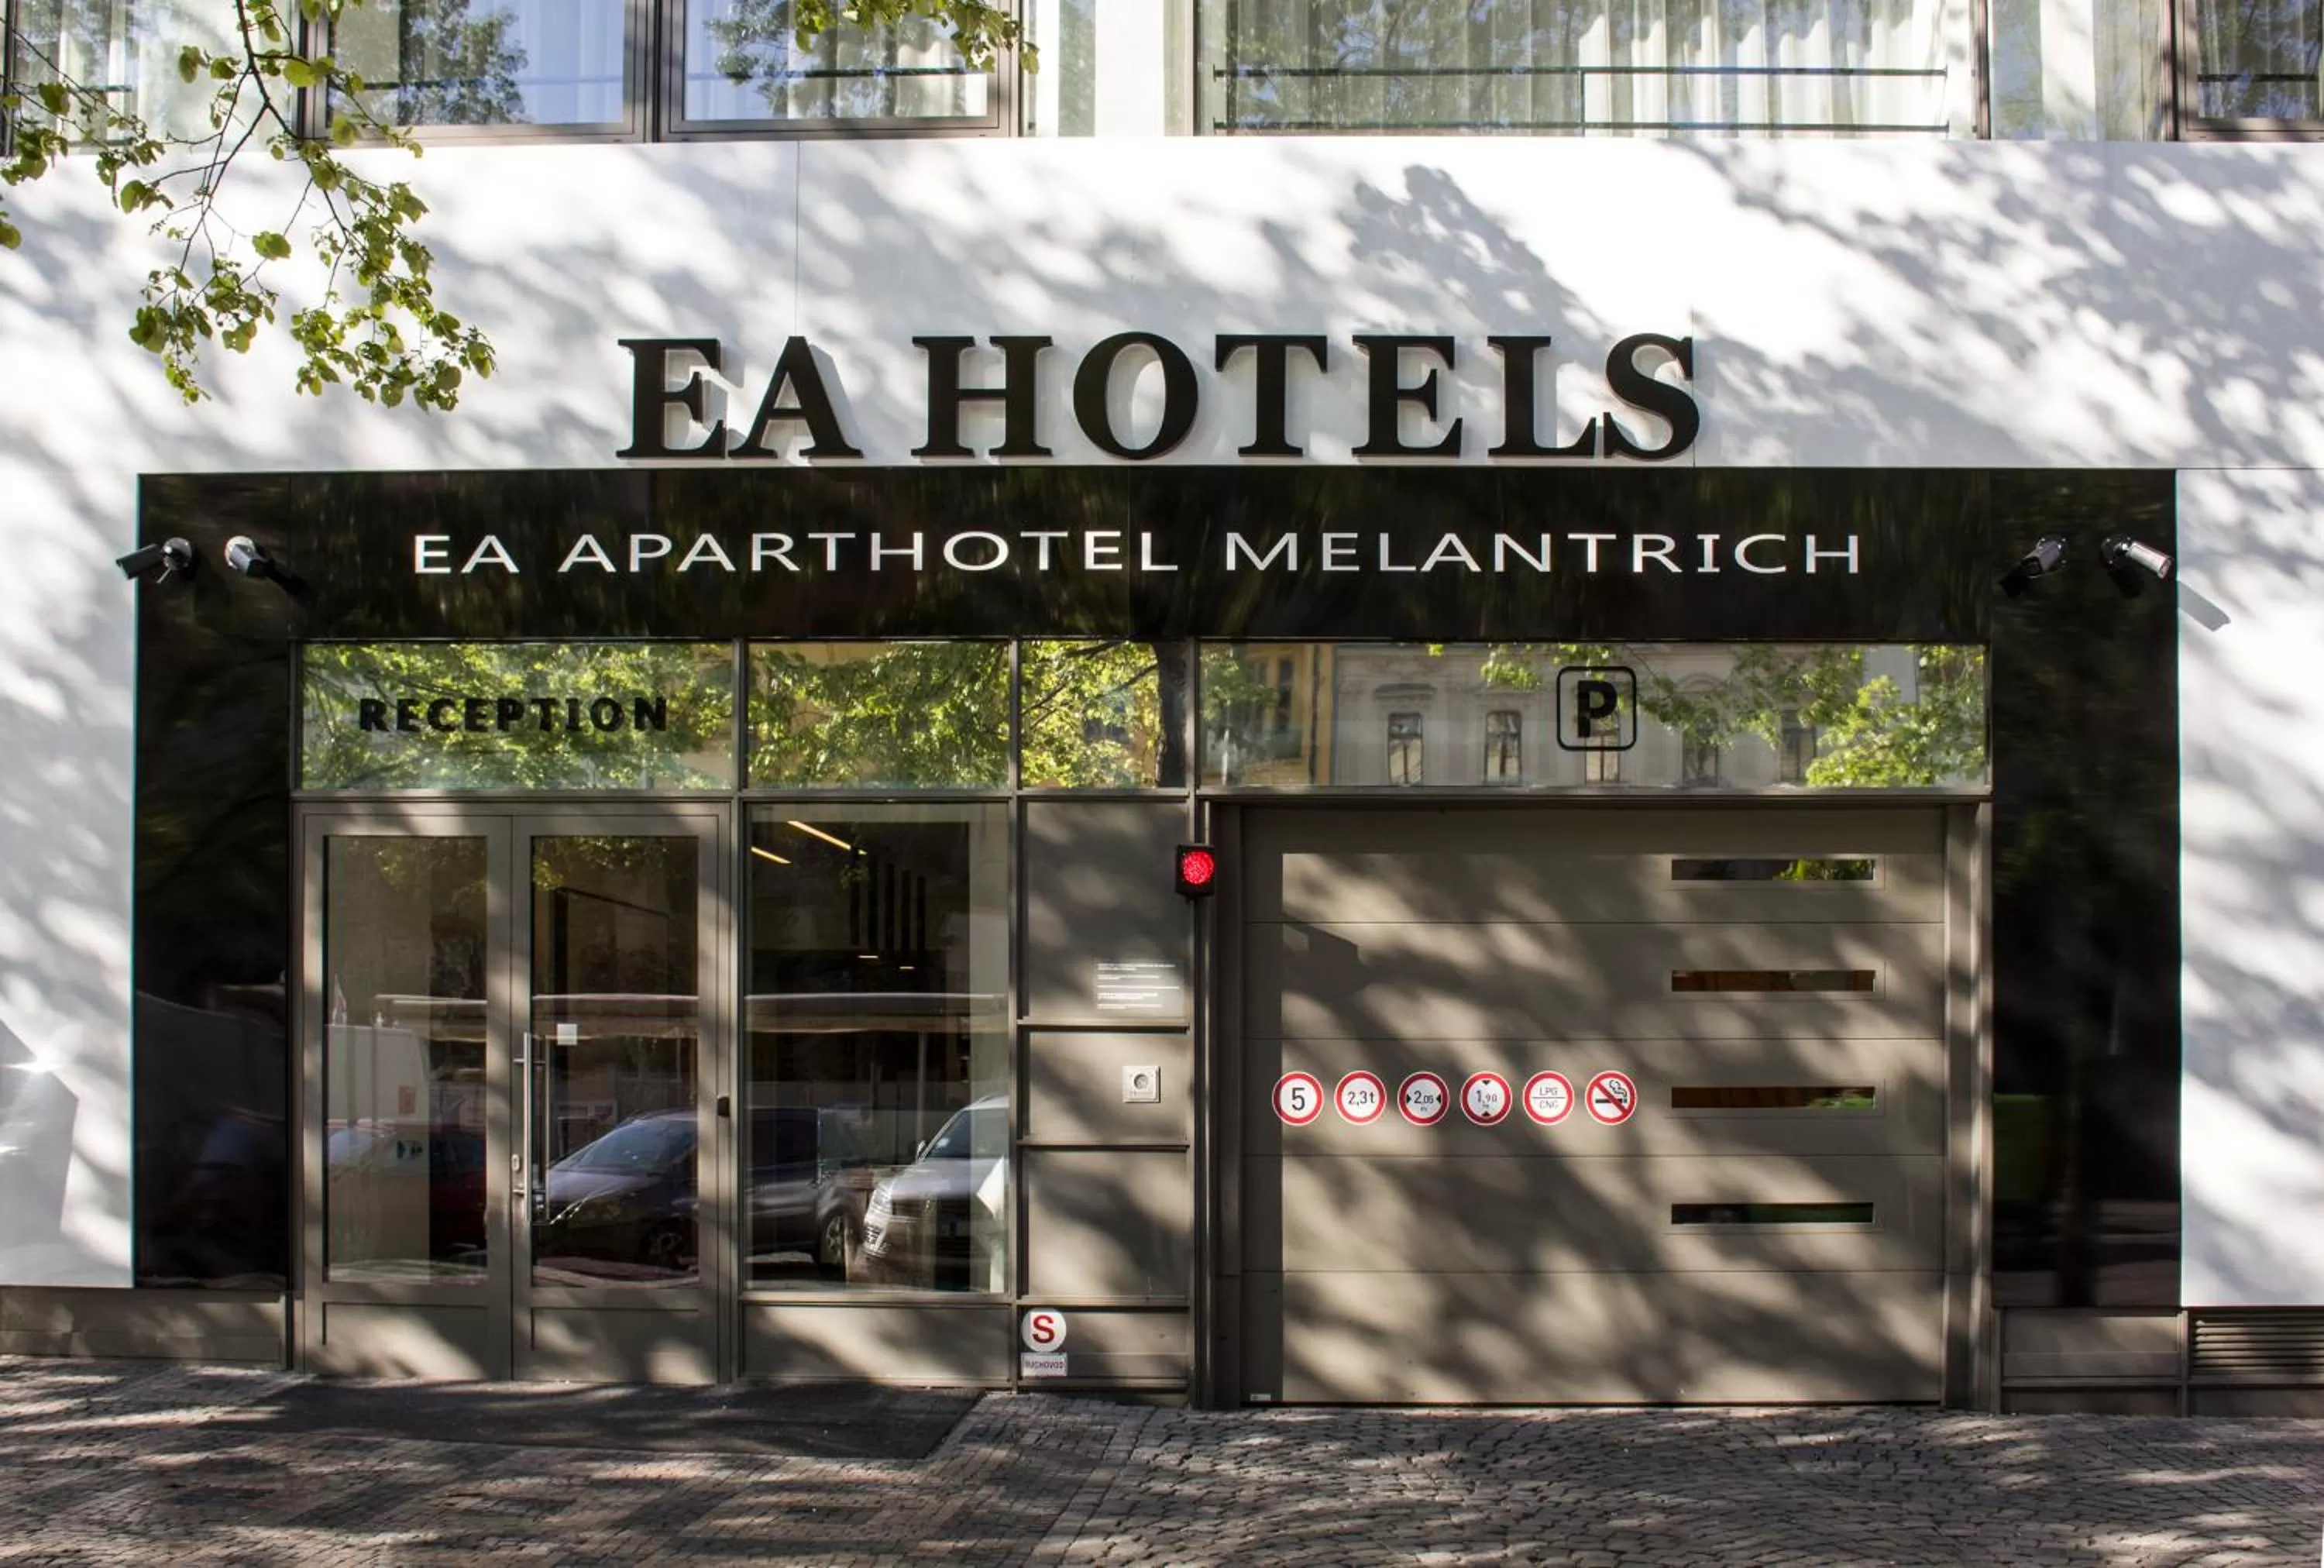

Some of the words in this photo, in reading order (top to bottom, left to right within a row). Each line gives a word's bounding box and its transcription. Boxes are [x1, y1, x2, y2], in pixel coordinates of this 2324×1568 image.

[617, 336, 864, 459] EA
[911, 332, 1700, 459] HOTELS
[414, 534, 519, 574] EA
[558, 531, 1177, 573] APARTHOTEL
[1226, 532, 1859, 574] MELANTRICH
[359, 697, 667, 732] RECEPTION
[1576, 680, 1618, 738] P
[1291, 1087, 1305, 1111] 5
[1539, 1087, 1558, 1095] LPG
[1539, 1101, 1559, 1109] CNG
[1032, 1315, 1055, 1344] S
